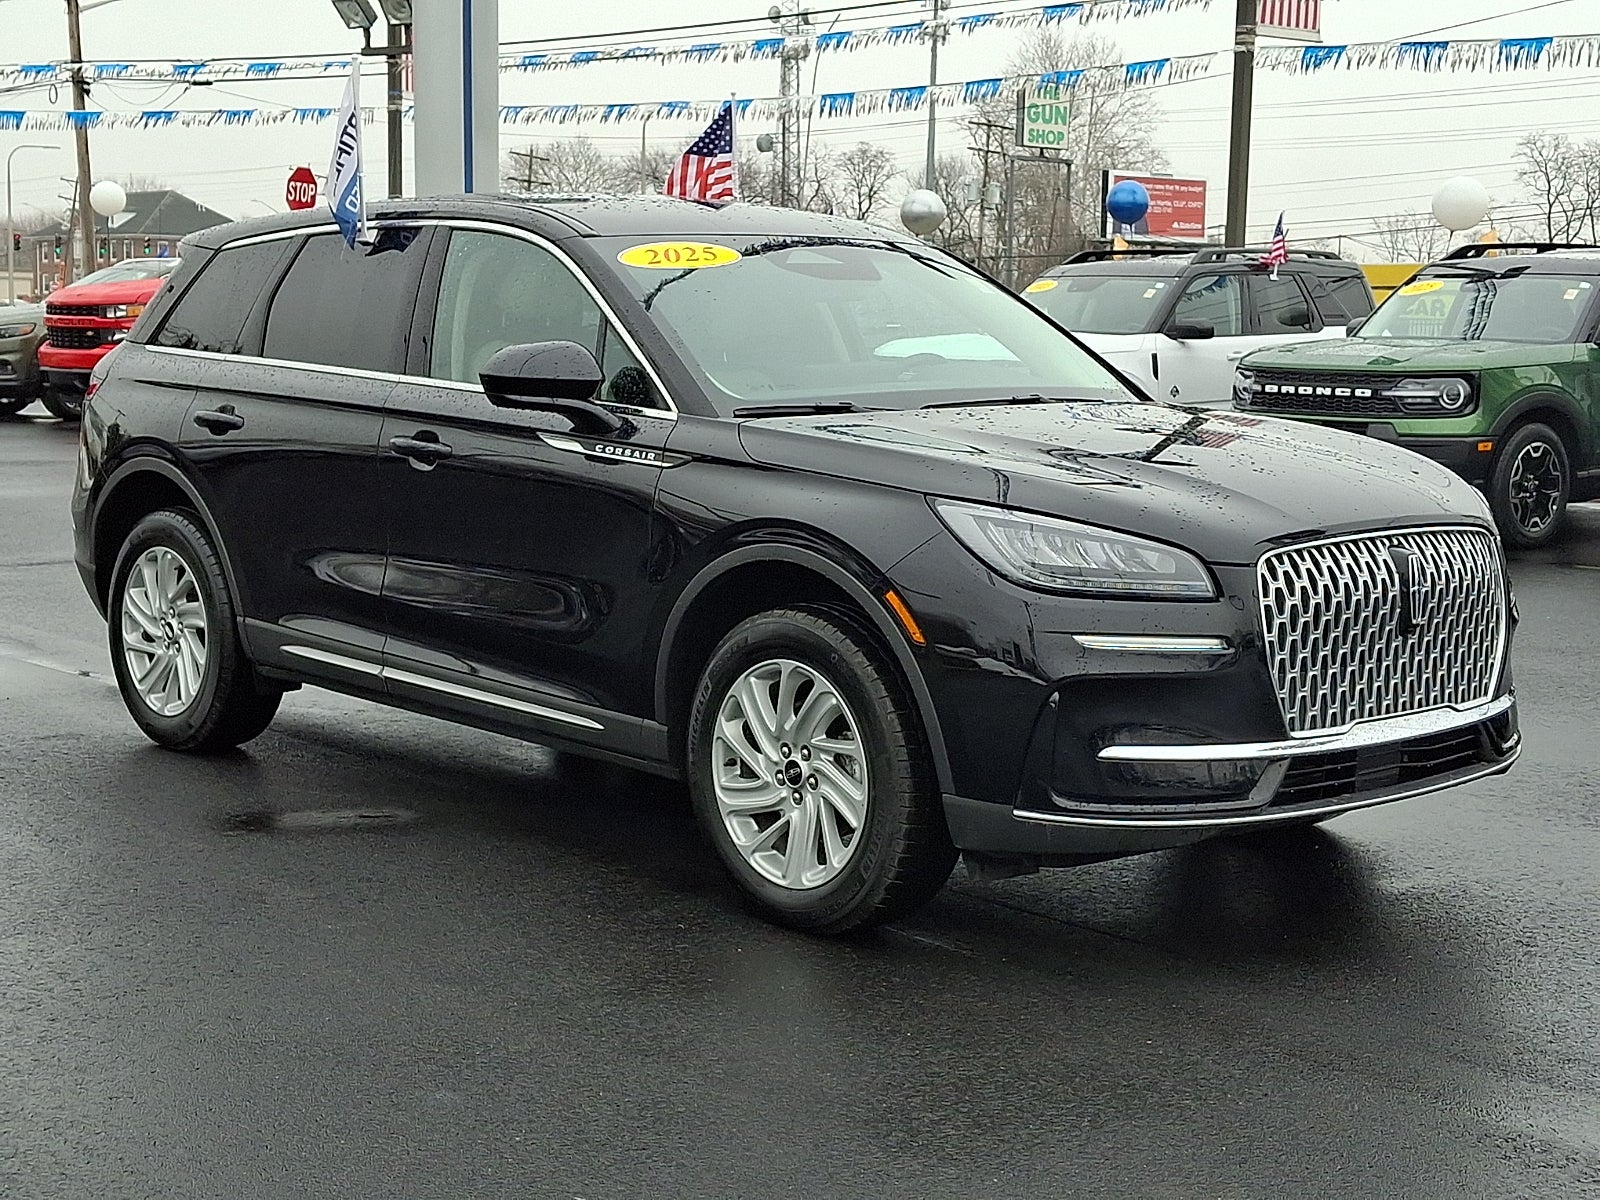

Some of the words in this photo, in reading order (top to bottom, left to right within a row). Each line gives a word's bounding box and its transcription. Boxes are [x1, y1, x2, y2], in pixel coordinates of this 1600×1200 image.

[1027, 103, 1068, 126] GUN
[1028, 128, 1065, 146] SHOP
[288, 181, 316, 203] STOP
[644, 246, 718, 265] 2025
[1264, 384, 1372, 397] BRONCO
[595, 444, 656, 461] CORSAIR
